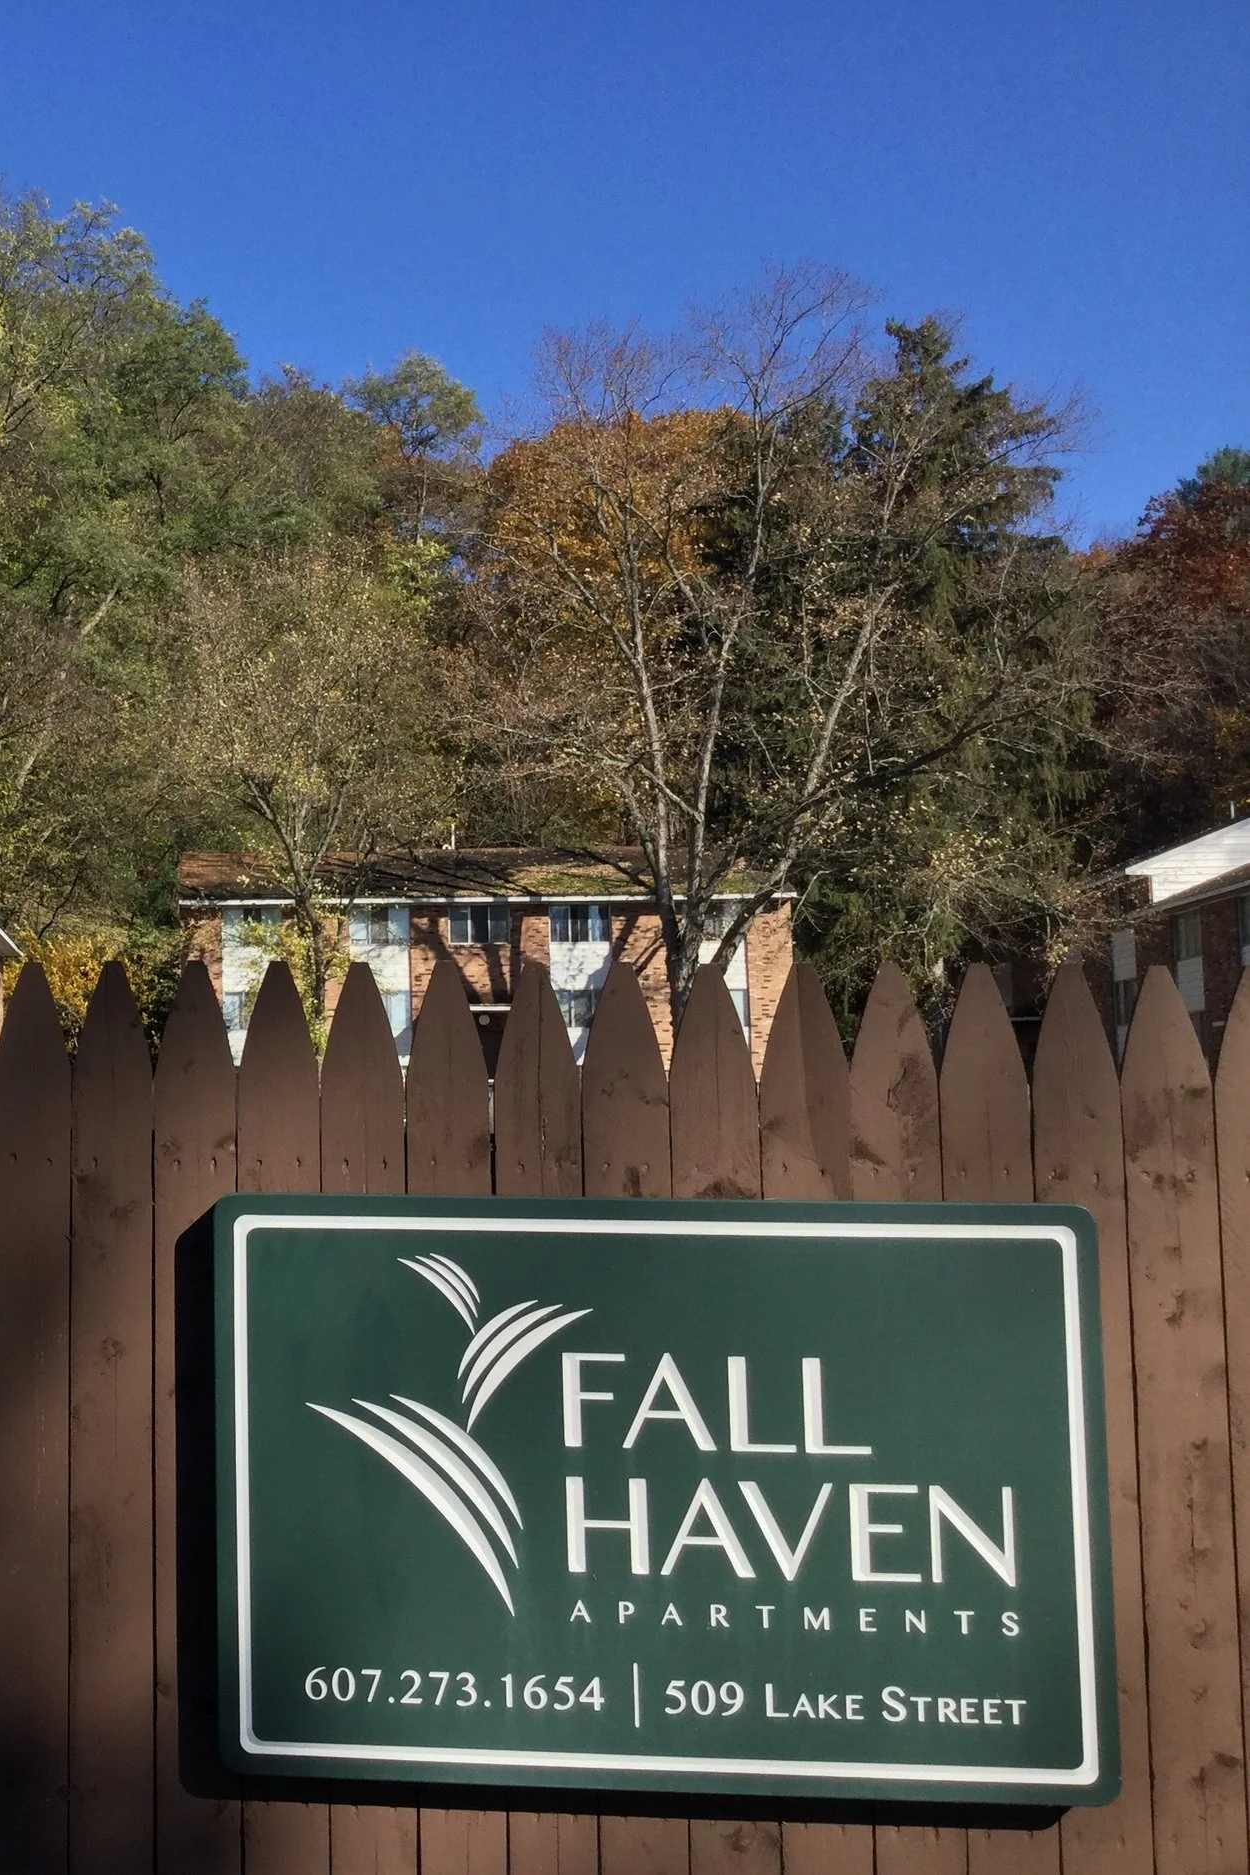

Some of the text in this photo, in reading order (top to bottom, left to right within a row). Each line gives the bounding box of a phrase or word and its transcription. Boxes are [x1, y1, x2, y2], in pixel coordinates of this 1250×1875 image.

[560, 1351, 874, 1457] FALL
[564, 1475, 1018, 1589] HAVEN
[568, 1598, 1022, 1638] APARTMENTS
[303, 1665, 607, 1713] 607.273.1654
[663, 1678, 746, 1718] 509
